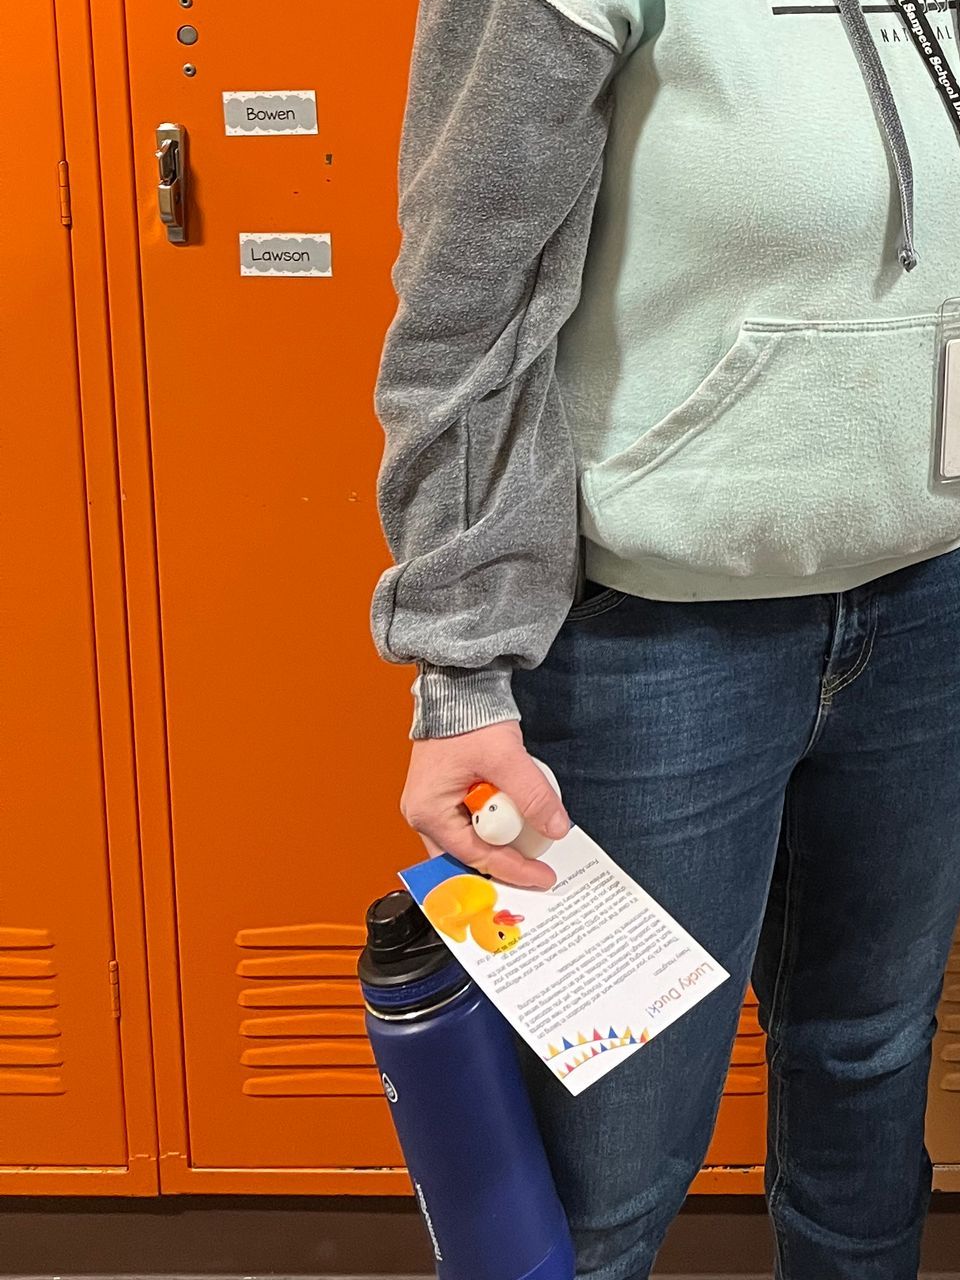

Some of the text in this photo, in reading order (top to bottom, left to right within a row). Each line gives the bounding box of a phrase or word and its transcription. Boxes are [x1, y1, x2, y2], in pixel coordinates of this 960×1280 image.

[902, 2, 933, 55] Sanpete
[928, 55, 960, 100] School
[246, 107, 296, 121] Bowen
[250, 247, 310, 262] Lawson
[644, 960, 713, 1018] Lucky Duck!
